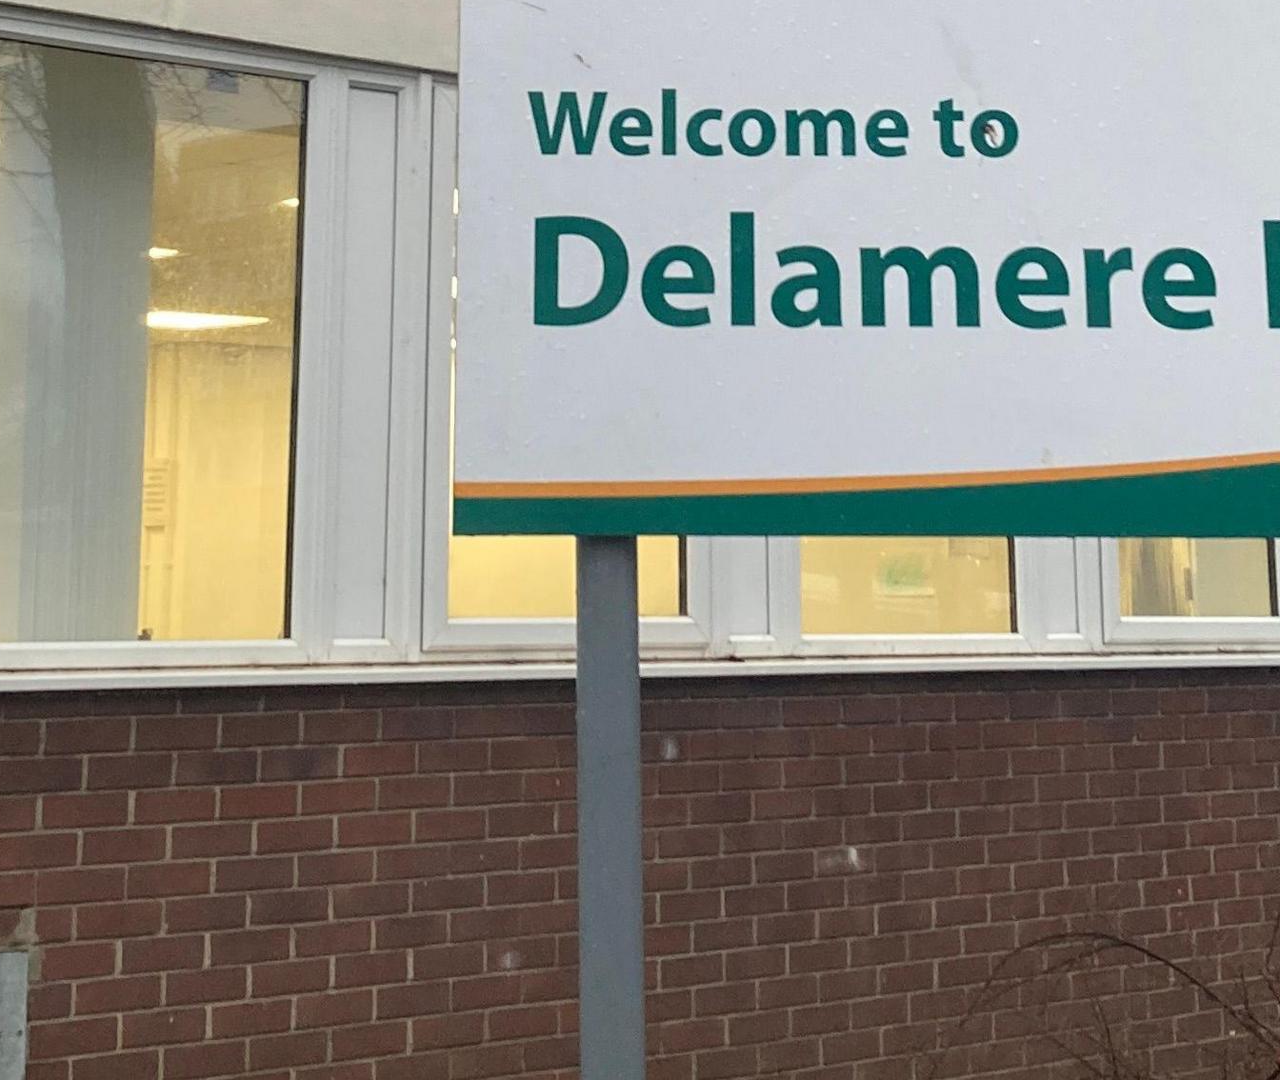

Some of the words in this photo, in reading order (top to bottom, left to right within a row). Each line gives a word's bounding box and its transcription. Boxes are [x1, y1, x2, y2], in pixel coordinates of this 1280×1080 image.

[528, 89, 908, 158] Welcome
[933, 99, 1019, 158] to
[533, 211, 1217, 331] Delamere
